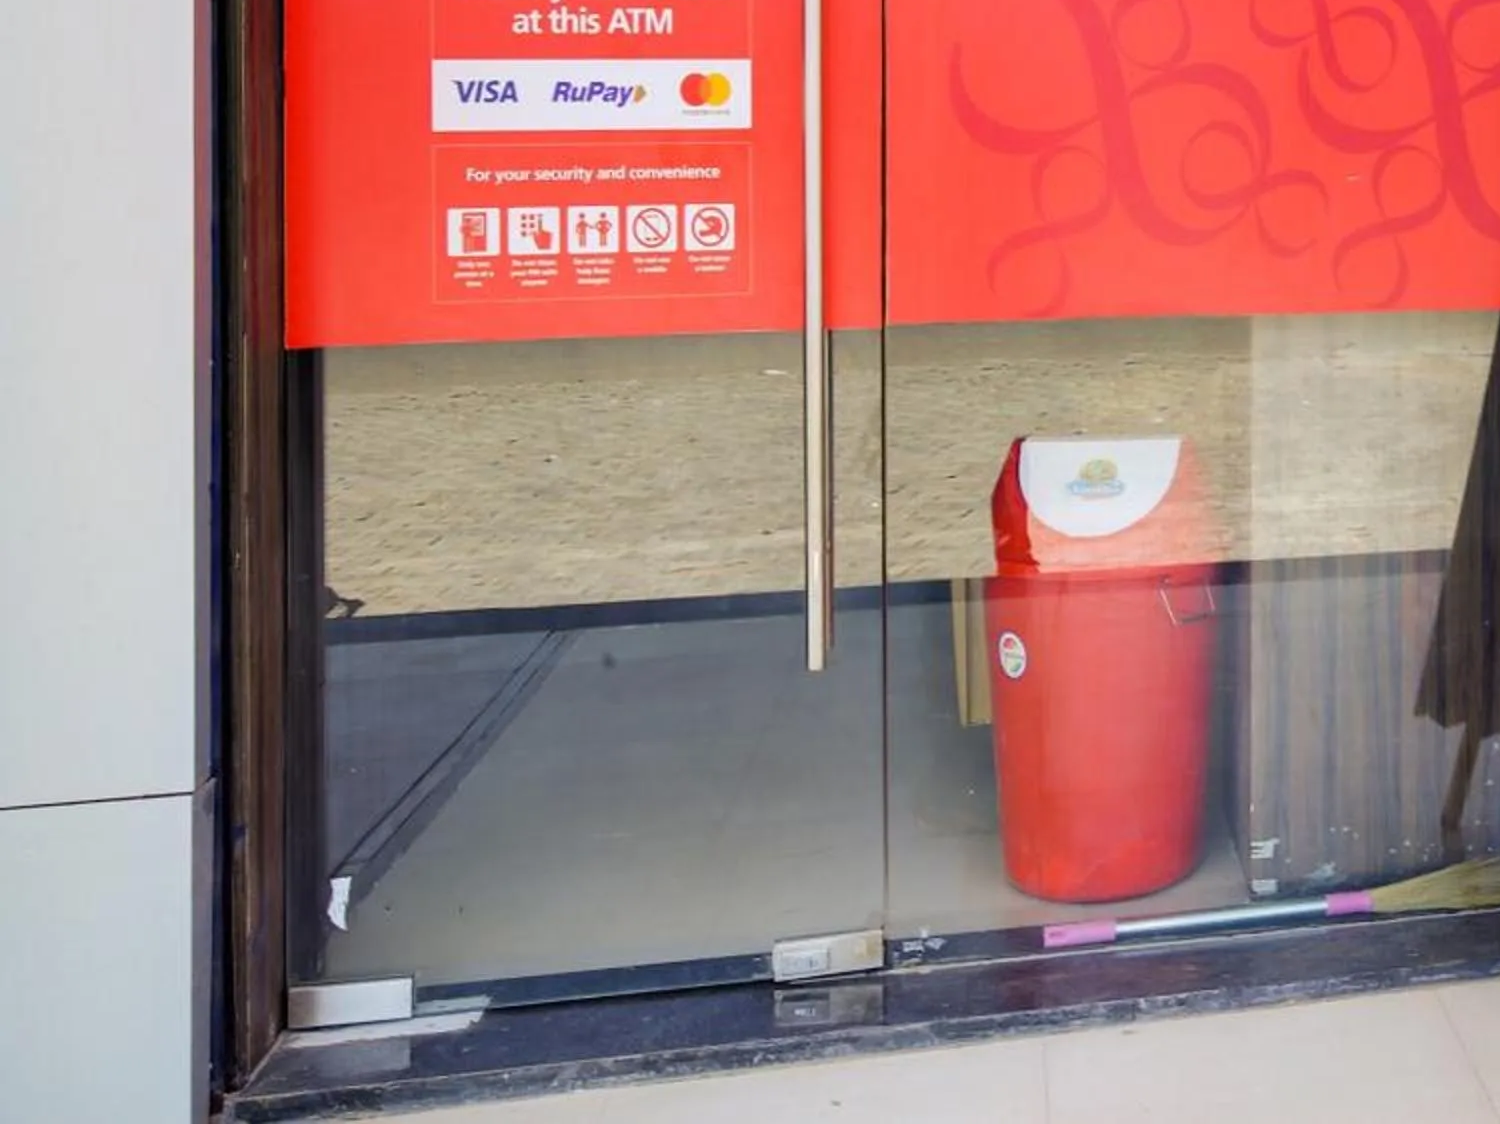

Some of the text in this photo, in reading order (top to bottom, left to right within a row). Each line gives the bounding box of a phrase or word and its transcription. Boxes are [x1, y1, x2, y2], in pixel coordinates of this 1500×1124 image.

[512, 7, 674, 35] at this ATM
[451, 79, 634, 108] VISA RuPay
[466, 164, 721, 185] For your security and convenience
